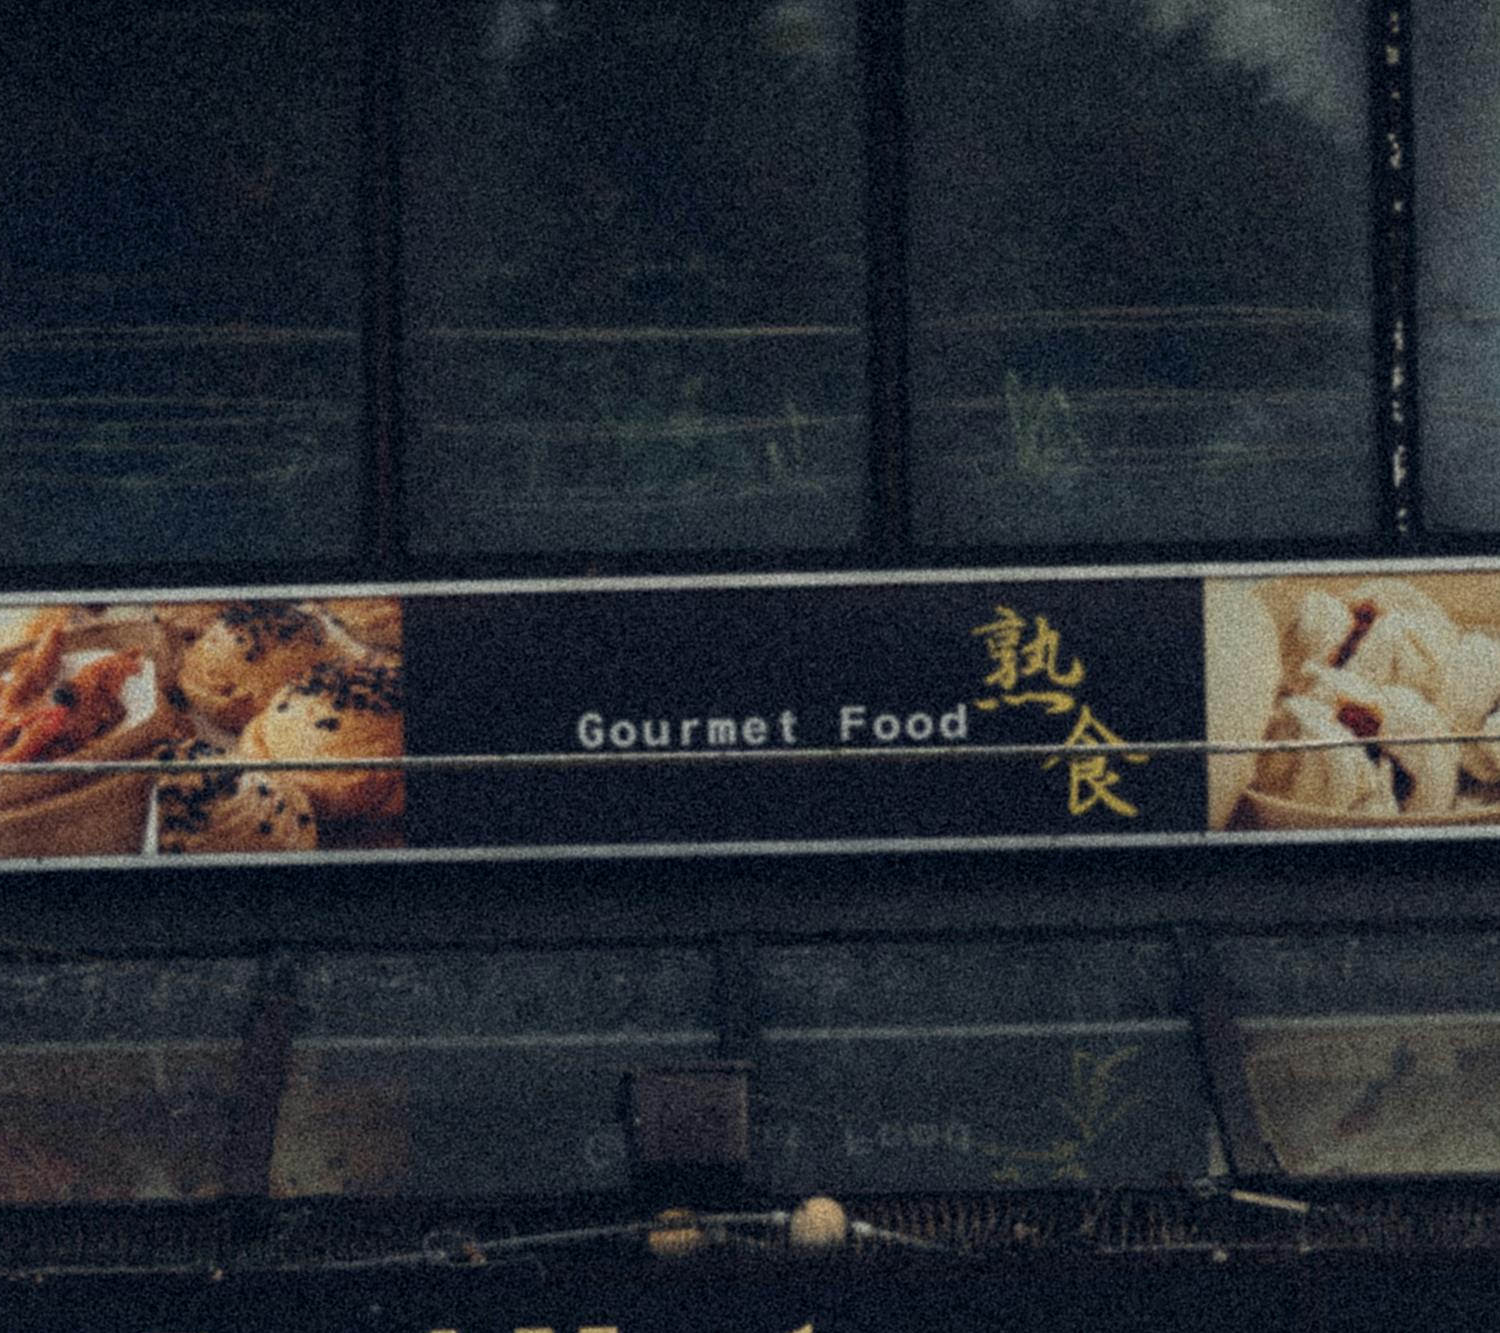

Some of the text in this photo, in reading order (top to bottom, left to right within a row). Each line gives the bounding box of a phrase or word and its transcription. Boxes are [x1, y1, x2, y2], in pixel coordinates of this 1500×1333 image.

[577, 703, 970, 750] Gourmet Food
[972, 605, 1150, 818] 熟食
